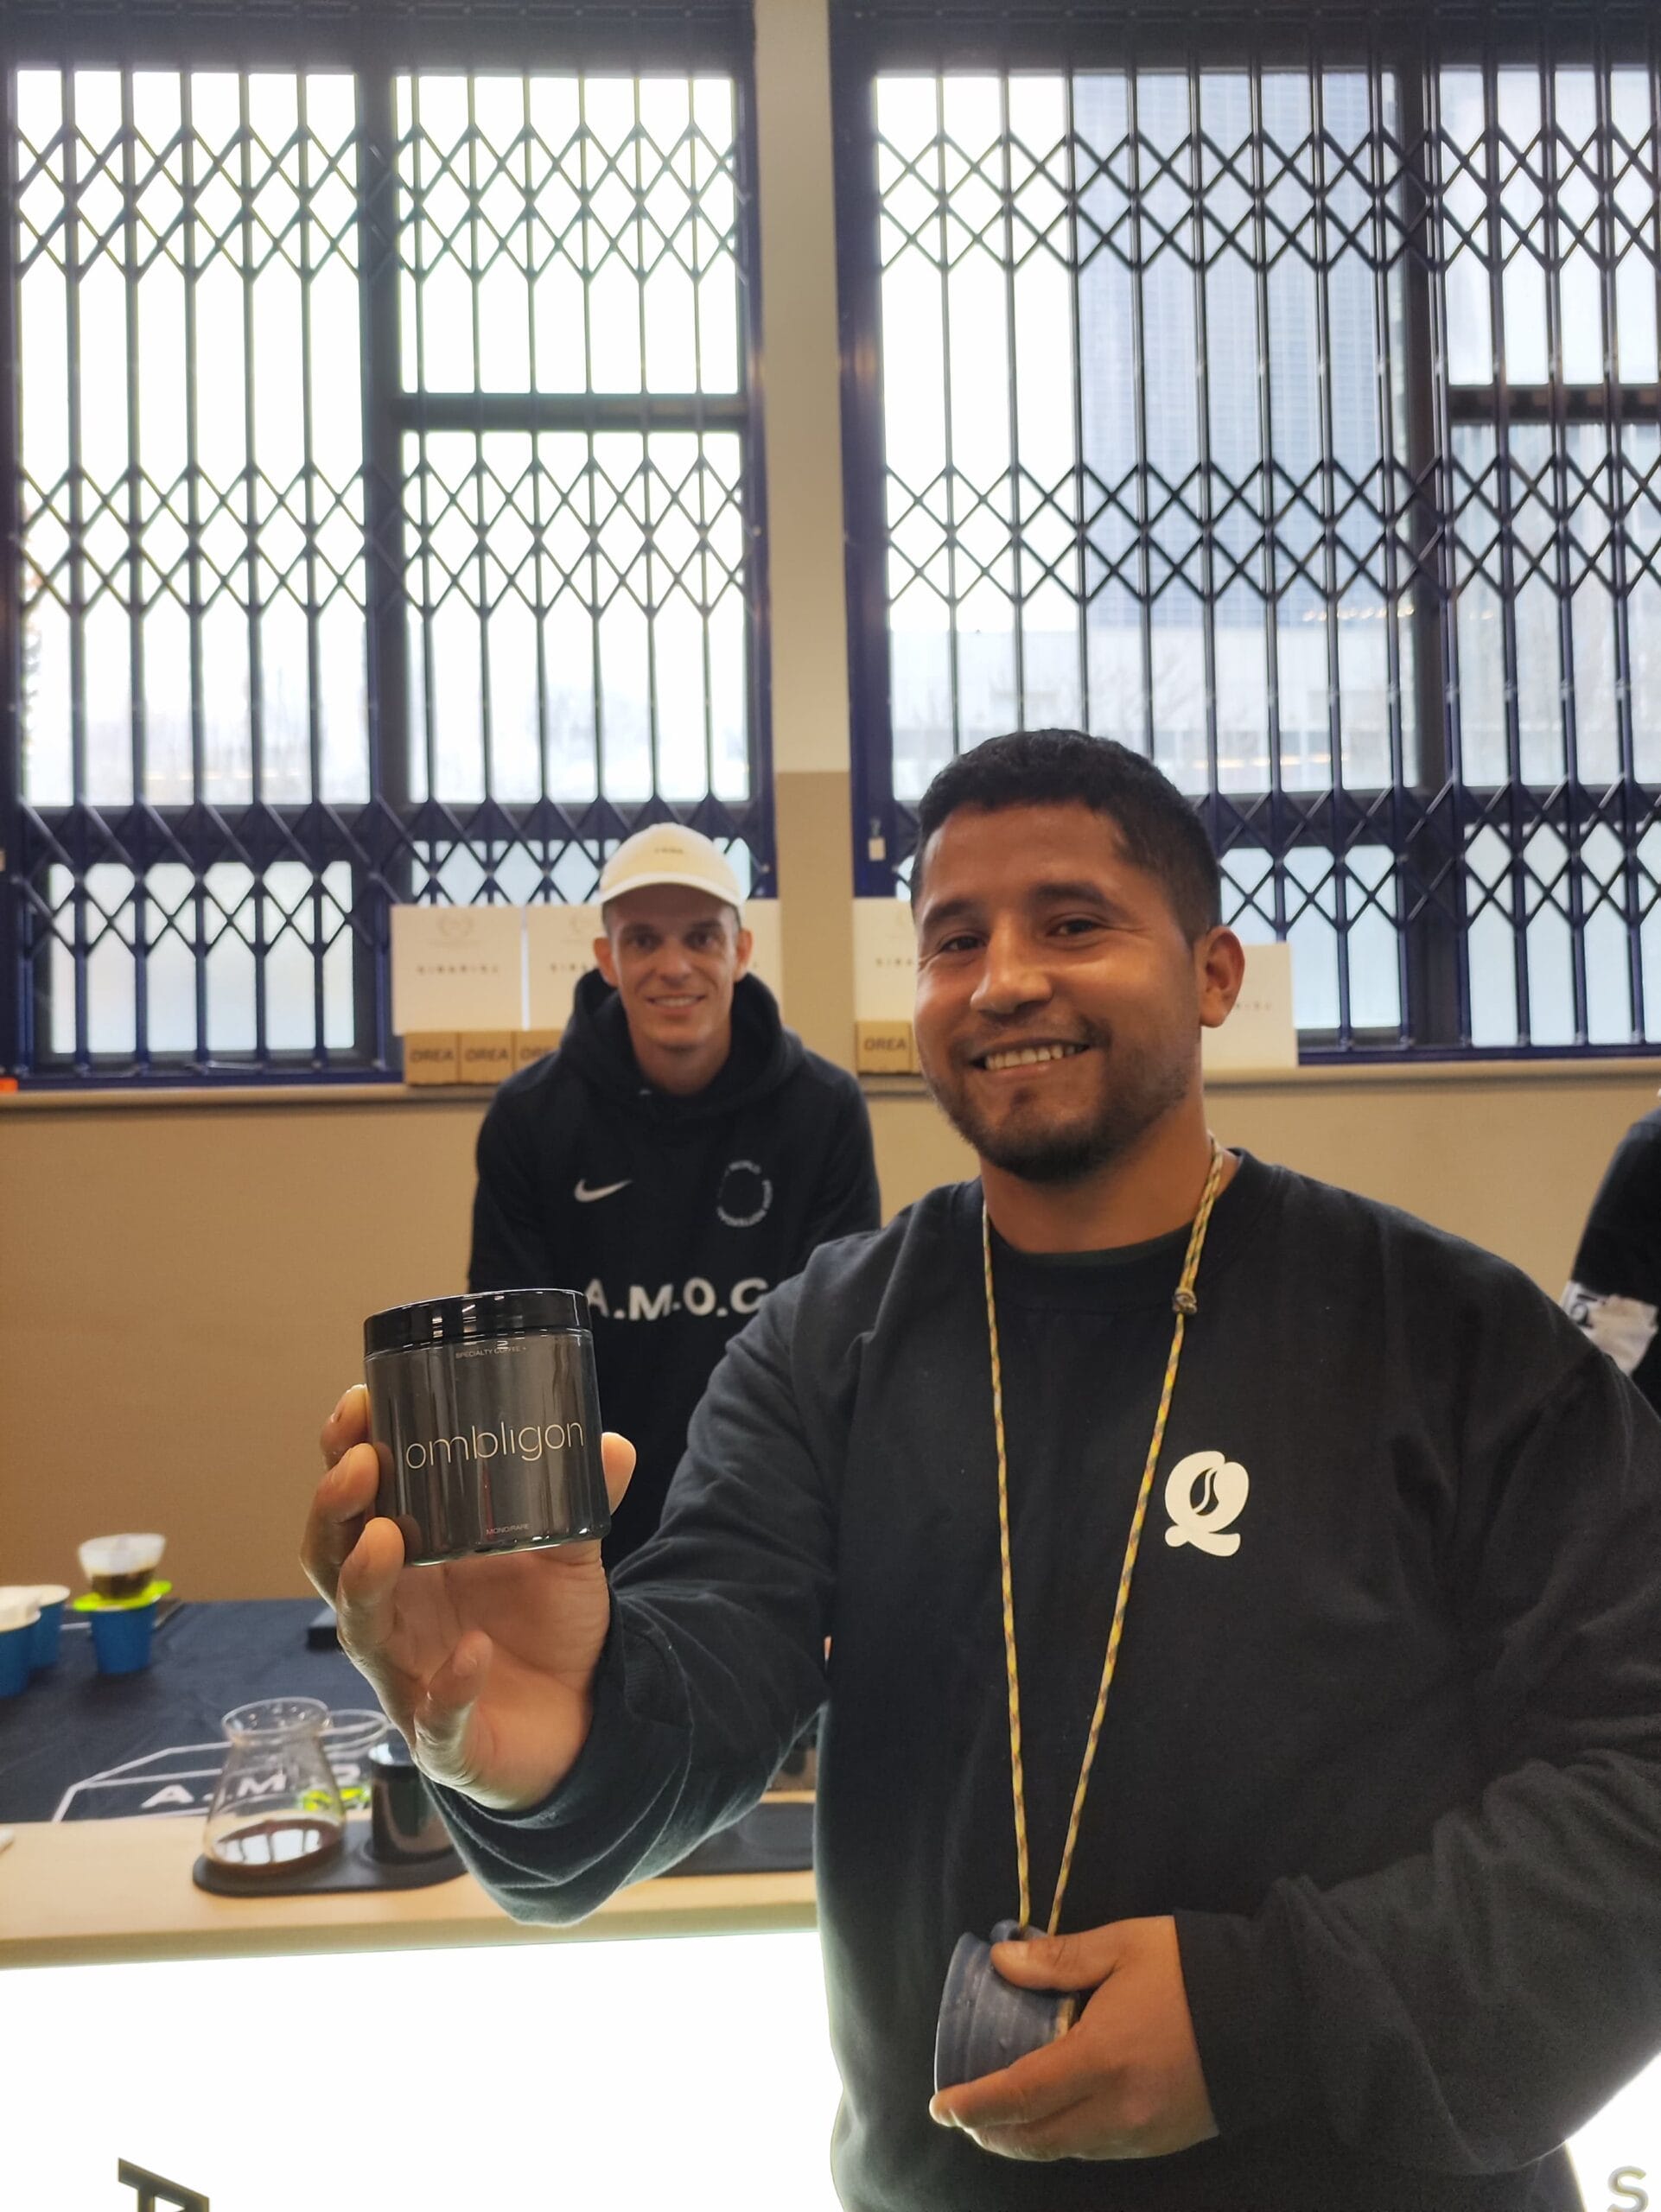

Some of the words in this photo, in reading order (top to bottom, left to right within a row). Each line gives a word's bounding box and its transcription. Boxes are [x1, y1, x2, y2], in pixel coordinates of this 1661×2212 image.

[864, 1038, 907, 1052] OREA
[410, 1048, 455, 1064] OREA
[465, 1048, 508, 1063] OREA
[405, 1421, 584, 1469] ombligon
